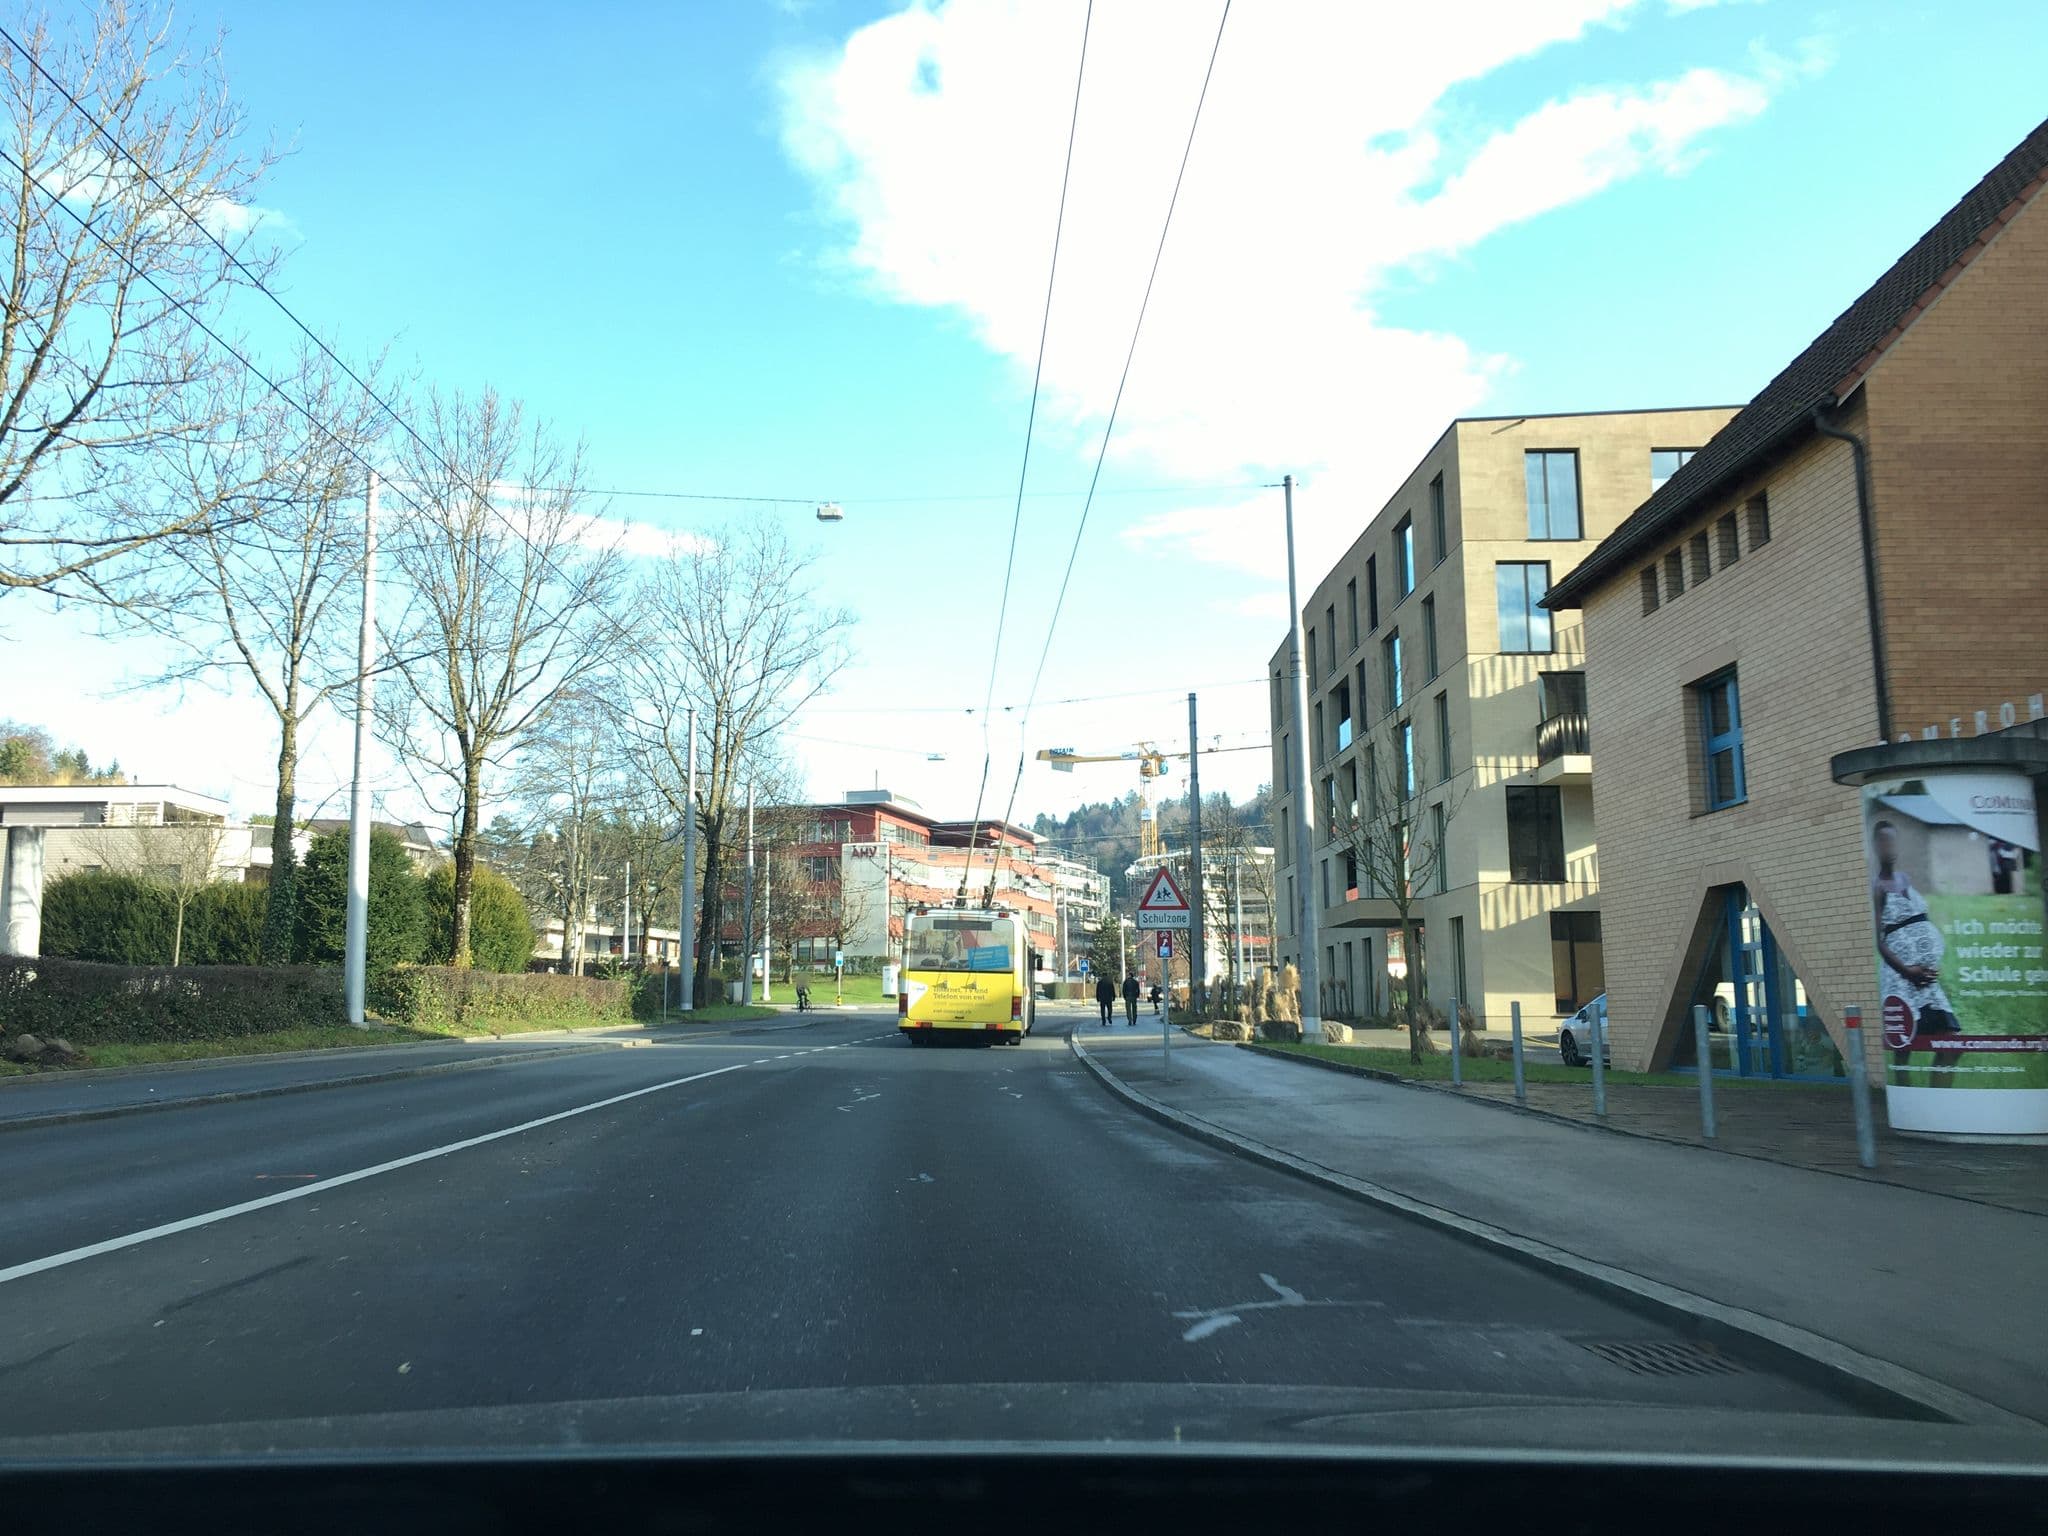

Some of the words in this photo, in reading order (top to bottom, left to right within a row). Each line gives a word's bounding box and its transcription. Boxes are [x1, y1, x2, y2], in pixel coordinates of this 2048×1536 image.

[851, 845, 877, 858] AHV
[1142, 913, 1187, 923] Schulzone
[1957, 942, 2019, 958] wieder
[1959, 966, 2022, 982] Schule
